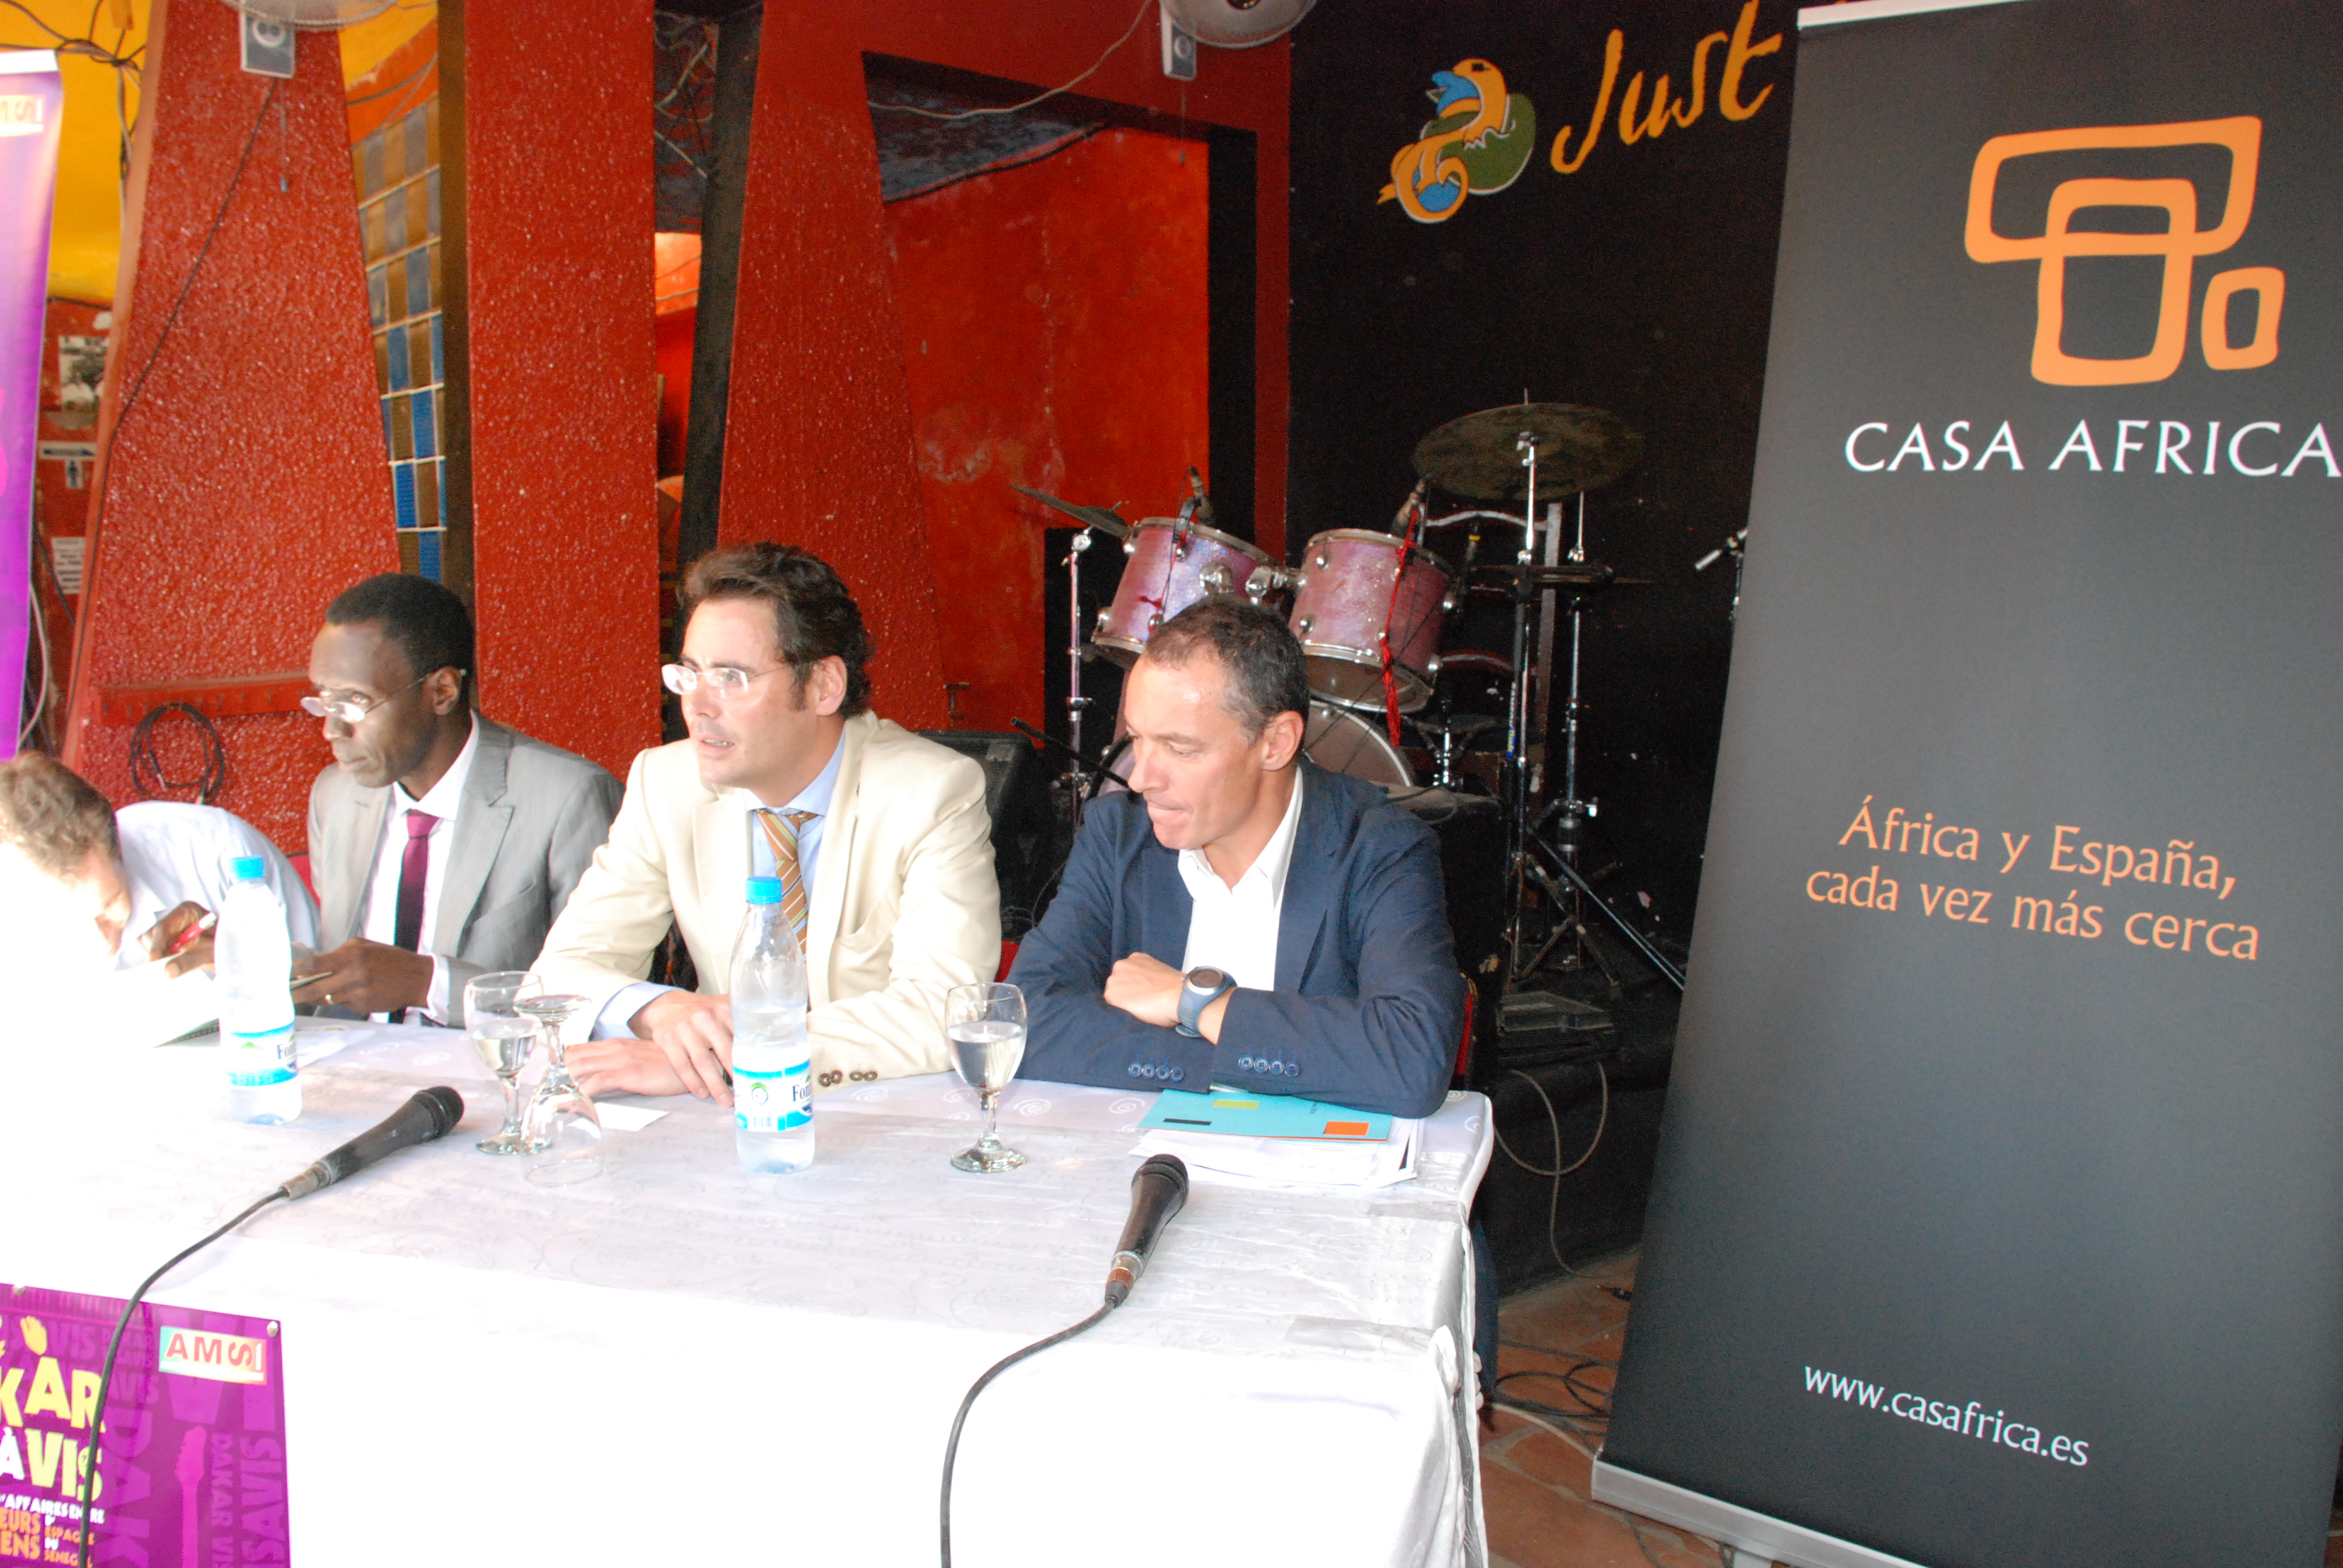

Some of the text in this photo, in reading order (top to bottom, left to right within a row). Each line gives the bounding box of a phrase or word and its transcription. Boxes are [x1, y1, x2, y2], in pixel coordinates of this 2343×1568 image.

[1550, 0, 1783, 174] Just
[1845, 419, 2342, 478] CASA AFRICA
[1838, 794, 2236, 900] África y España,
[1807, 864, 2260, 961] cada vez más cerca
[0, 1356, 106, 1433] KAR
[1804, 1365, 2089, 1466] www.casafrica.es
[24, 1428, 103, 1502] VIS
[44, 1525, 95, 1546] ESPAGE
[68, 1503, 105, 1524] ENRE
